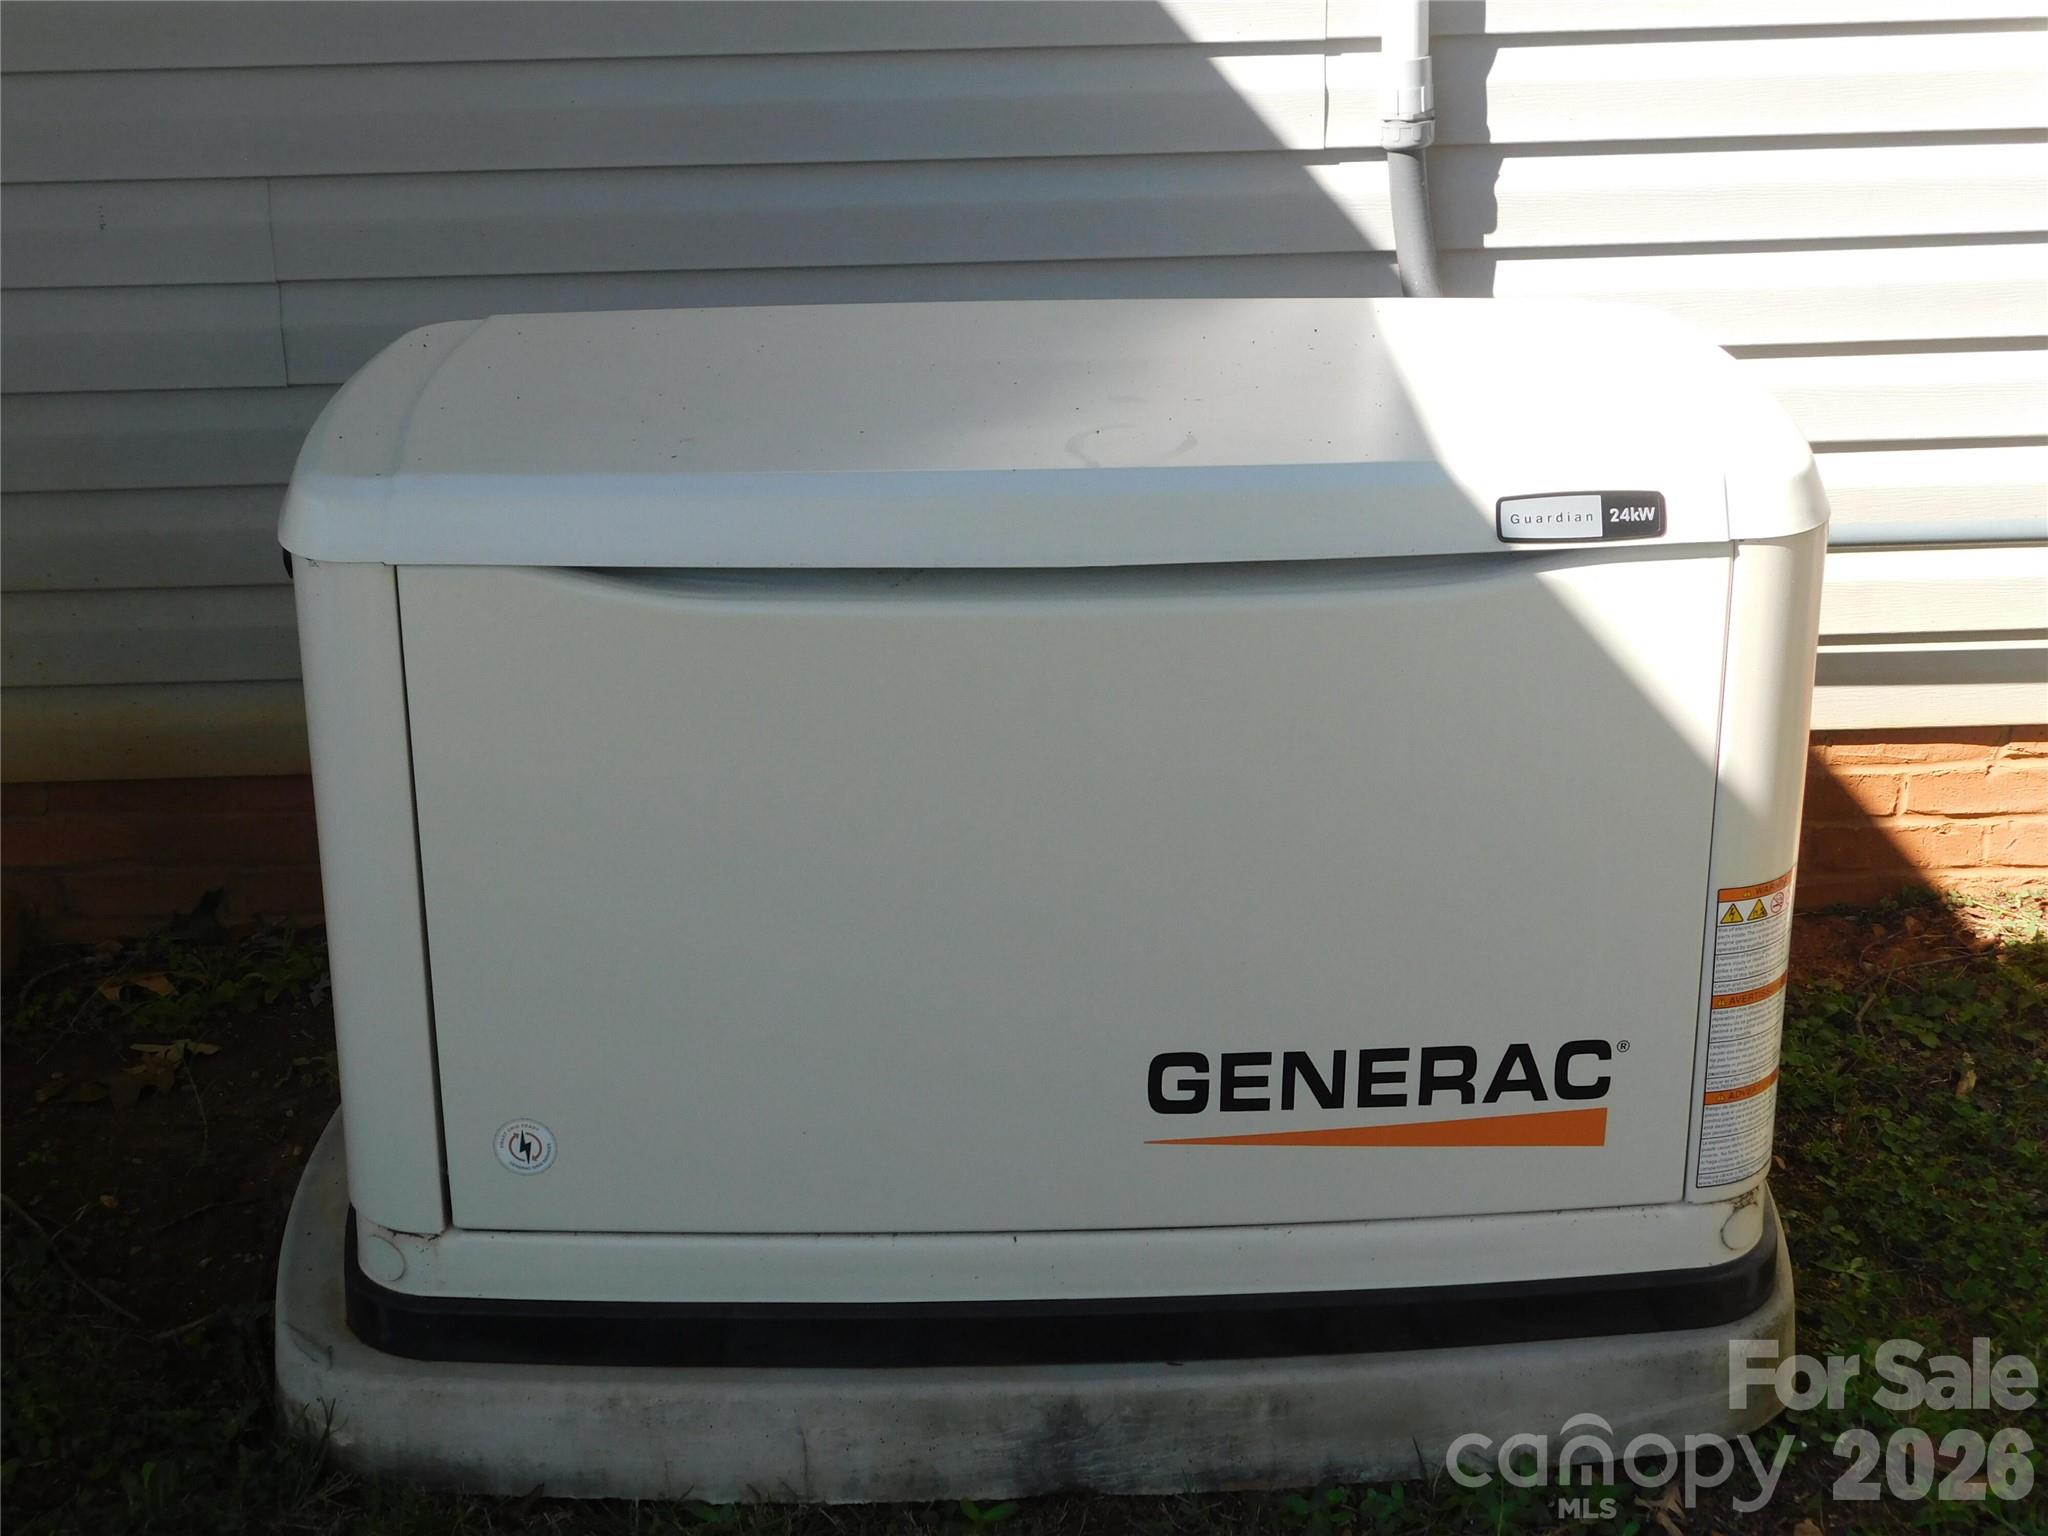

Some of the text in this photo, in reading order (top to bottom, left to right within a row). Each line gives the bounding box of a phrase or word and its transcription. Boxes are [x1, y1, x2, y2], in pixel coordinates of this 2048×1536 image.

[1510, 507, 1656, 525] Guardian 24kW
[1148, 1039, 1612, 1114] GENERAC
